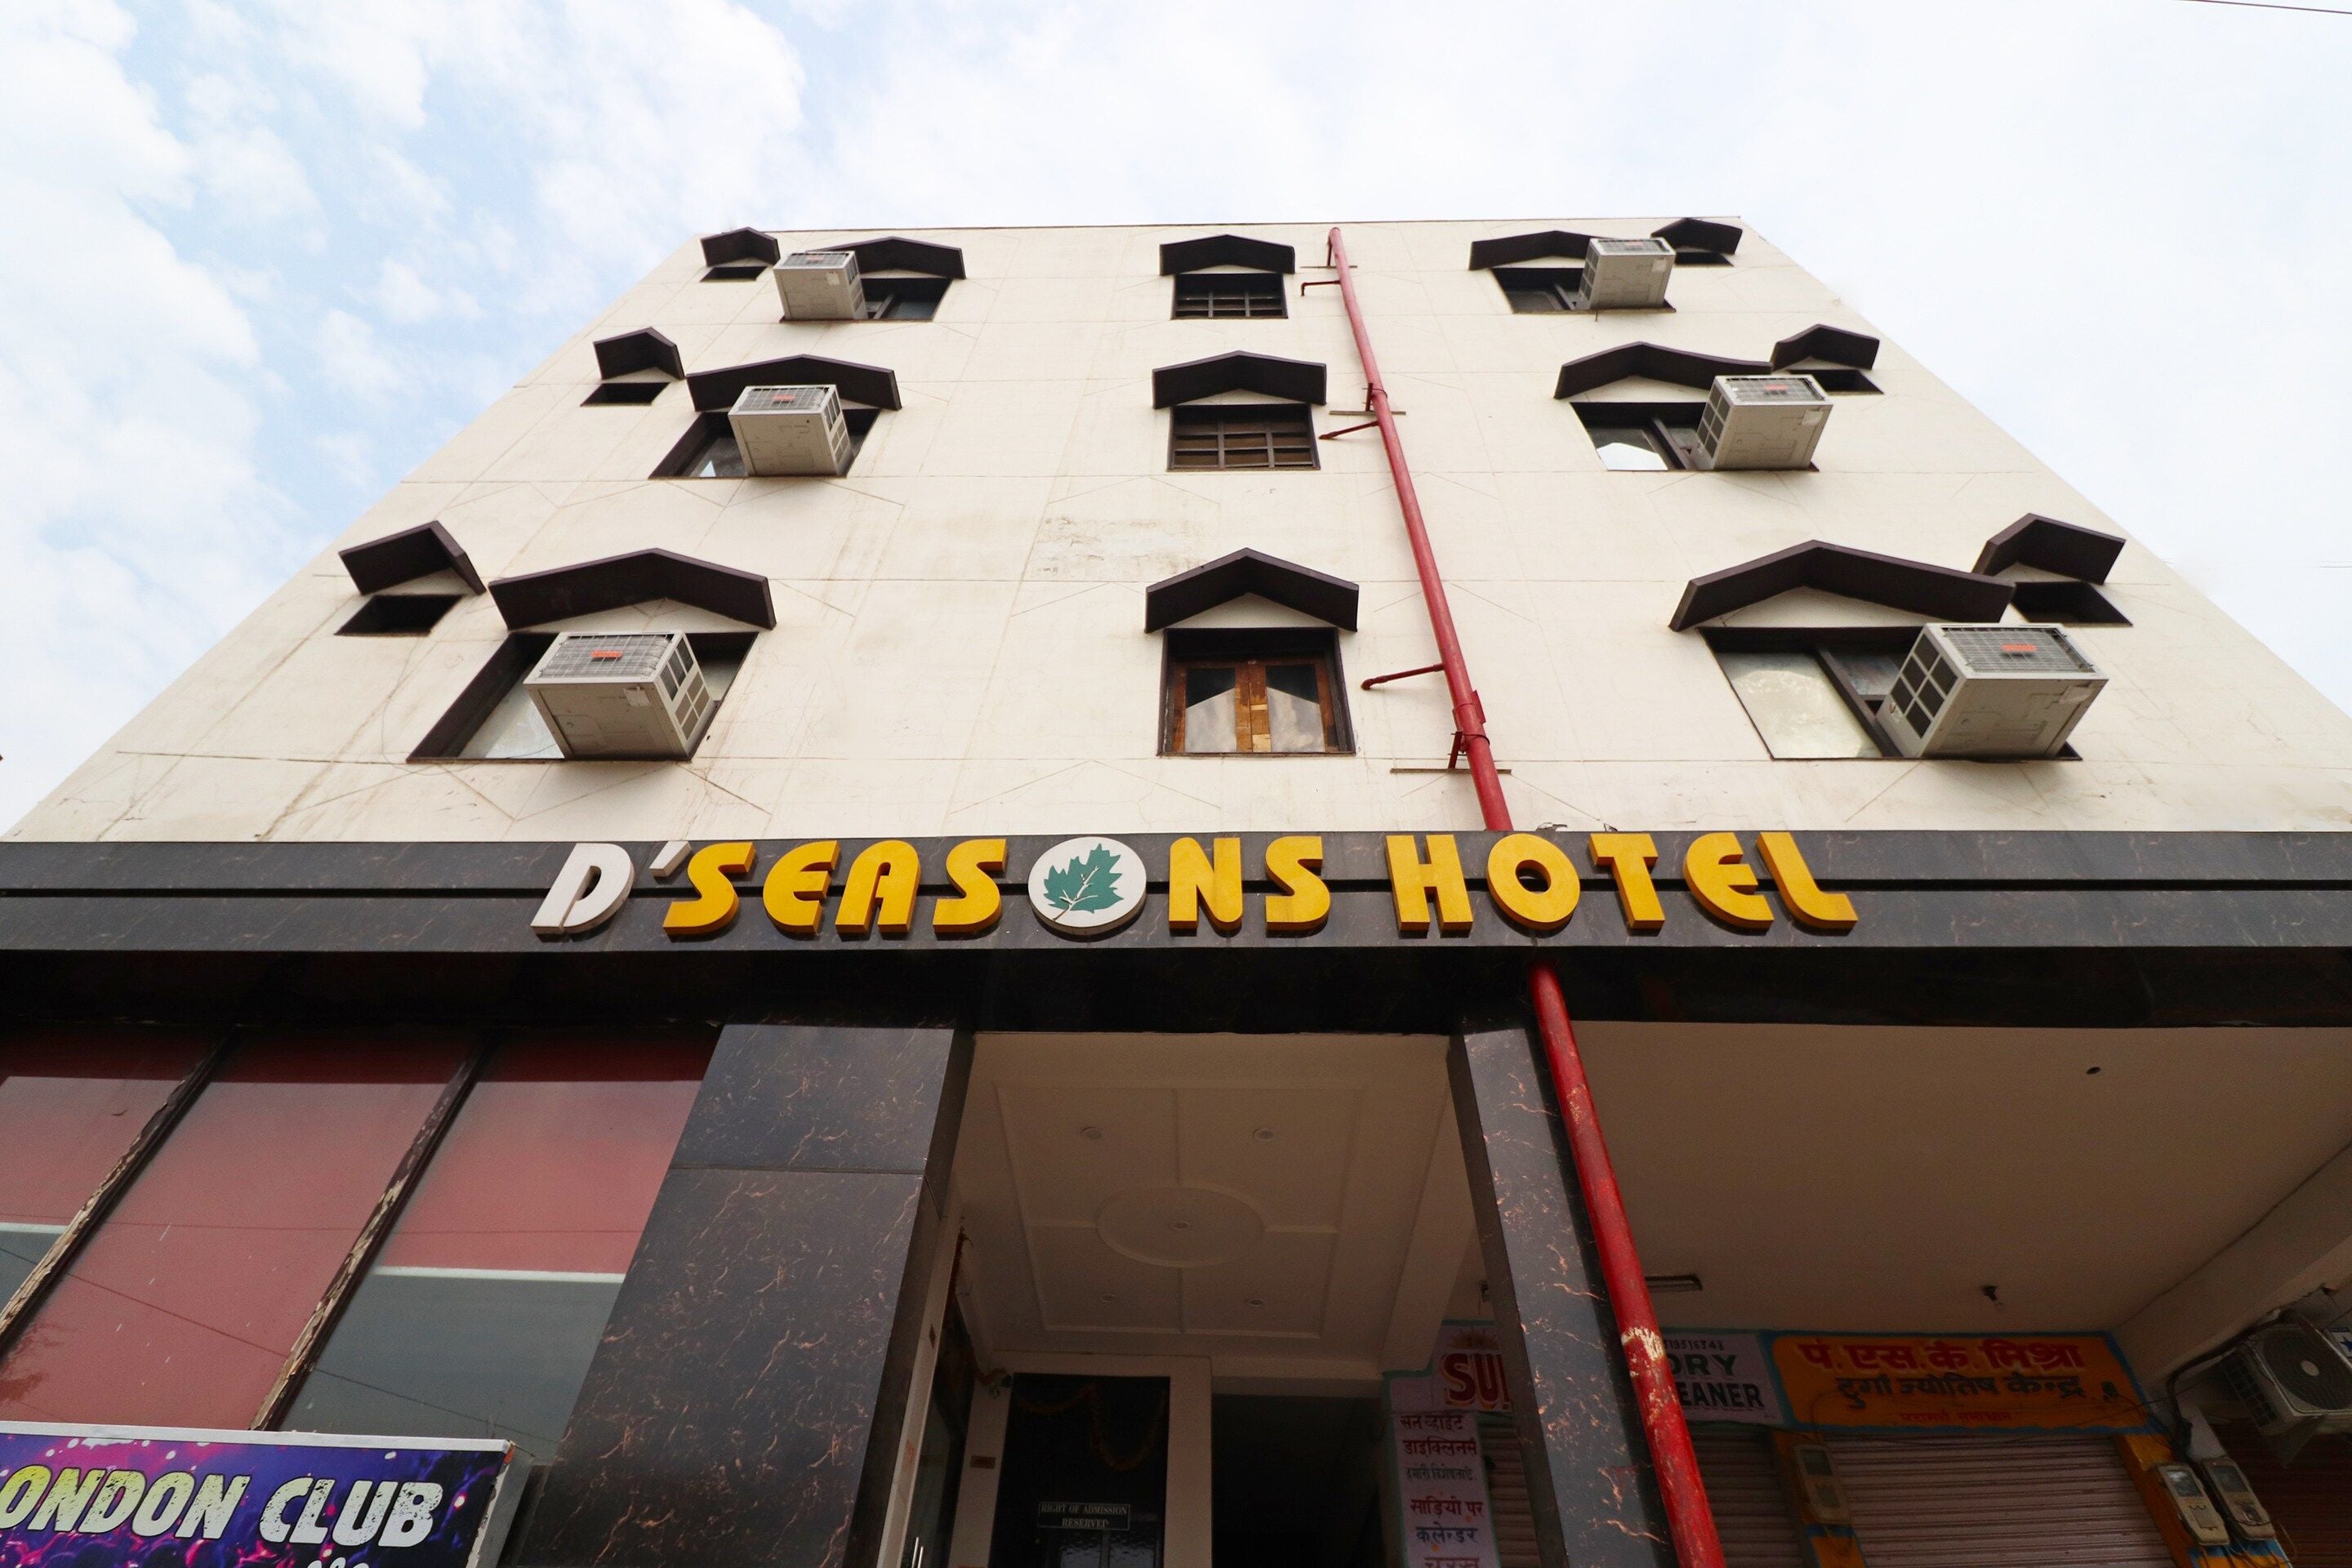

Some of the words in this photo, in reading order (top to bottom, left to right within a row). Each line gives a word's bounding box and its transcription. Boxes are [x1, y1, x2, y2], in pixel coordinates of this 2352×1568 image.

[1386, 831, 1860, 932] HOTEL
[259, 1477, 443, 1547] CLUB
[1040, 1503, 1067, 1513] RIGHT
[1068, 1505, 1080, 1513] OF
[1084, 1505, 1127, 1515] ADMISSION
[1464, 1501, 1484, 1517] पर
[1062, 1518, 1110, 1528] RESERVED
